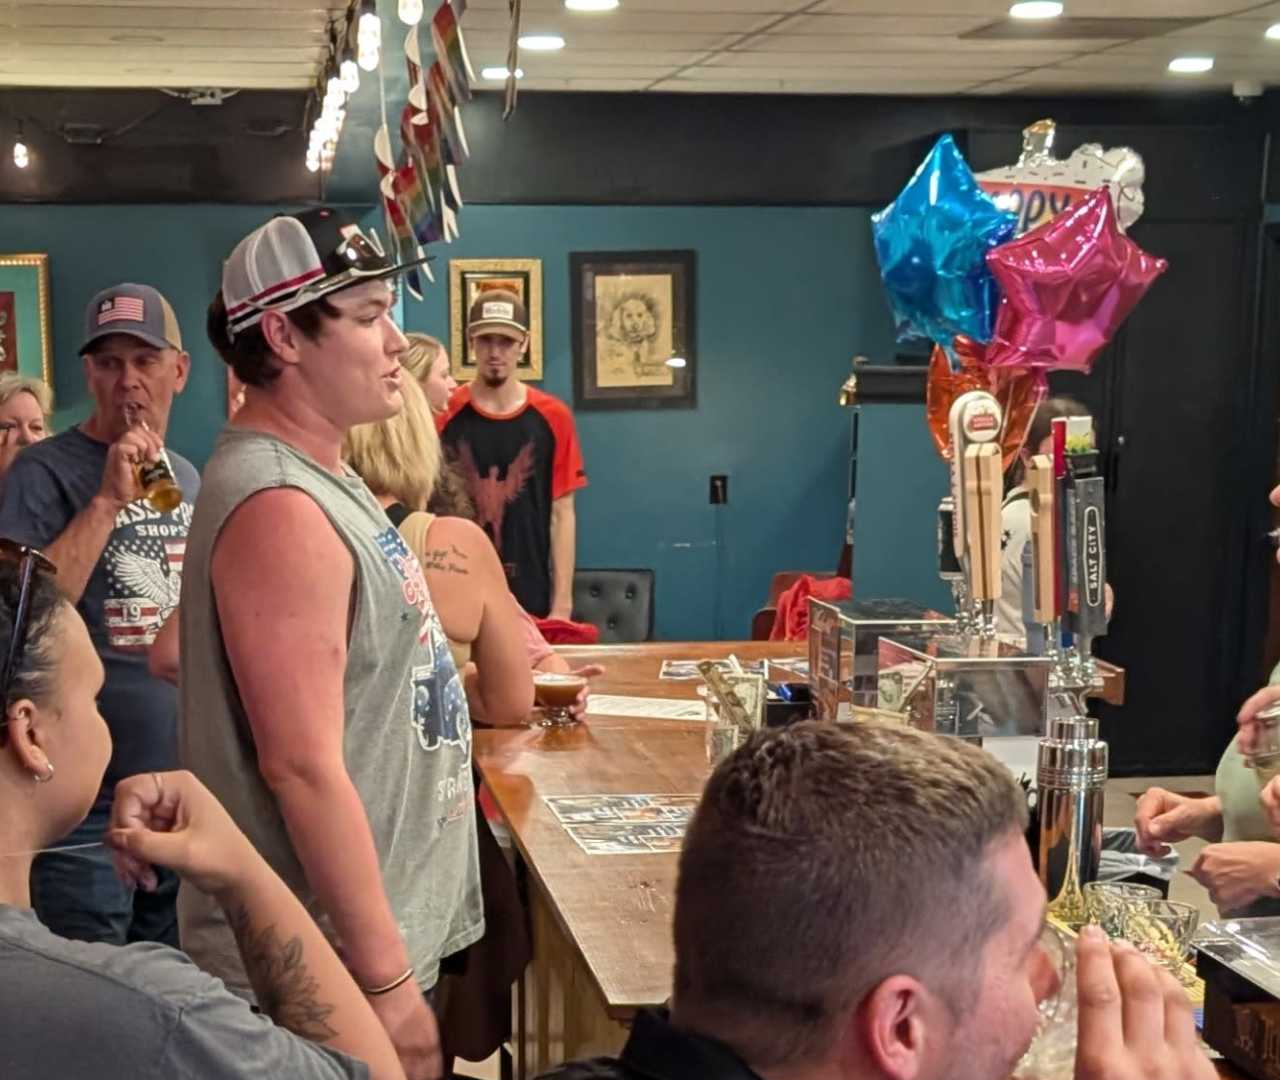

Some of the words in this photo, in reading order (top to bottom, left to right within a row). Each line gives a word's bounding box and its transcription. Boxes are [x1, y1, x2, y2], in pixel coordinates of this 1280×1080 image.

[115, 497, 162, 529] ASS
[135, 524, 190, 538] SHOPS
[1087, 523, 1098, 555] CITY
[1088, 557, 1099, 591] SALT
